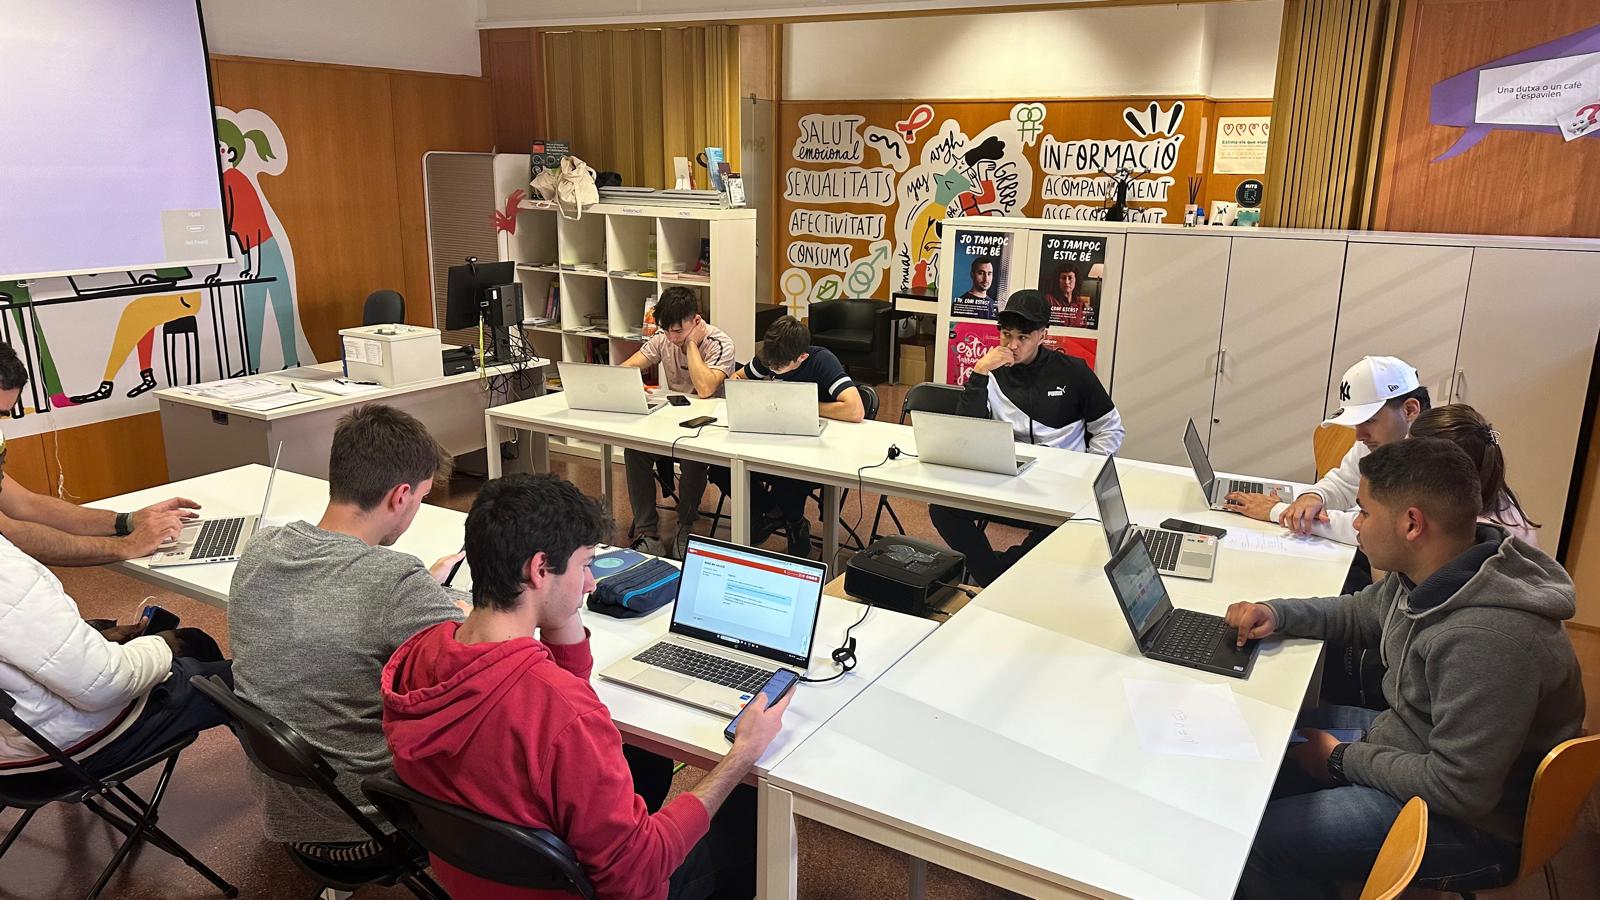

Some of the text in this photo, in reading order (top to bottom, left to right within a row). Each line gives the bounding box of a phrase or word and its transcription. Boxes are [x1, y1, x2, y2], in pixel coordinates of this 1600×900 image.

[1497, 86, 1514, 94] Una
[1516, 84, 1540, 93] dutxa
[1515, 91, 1561, 101] t'espavilen
[800, 119, 859, 145] SALUT
[797, 144, 861, 160] emocional
[930, 130, 964, 164] argh
[1043, 137, 1180, 170] INFORMACIÓ
[787, 171, 892, 203] SEXUALITATS
[907, 172, 929, 201] yay
[791, 212, 884, 238] AFECTIVITATS
[960, 235, 1009, 246] JO TAMPOC
[966, 244, 1001, 256] ESTIC BÉ
[1047, 239, 1101, 250] JO TAMPOC
[788, 244, 850, 268] CONSUMS
[900, 243, 909, 290] smuak
[1053, 249, 1092, 262] ESTIC BÉ
[1340, 381, 1351, 401] NY
